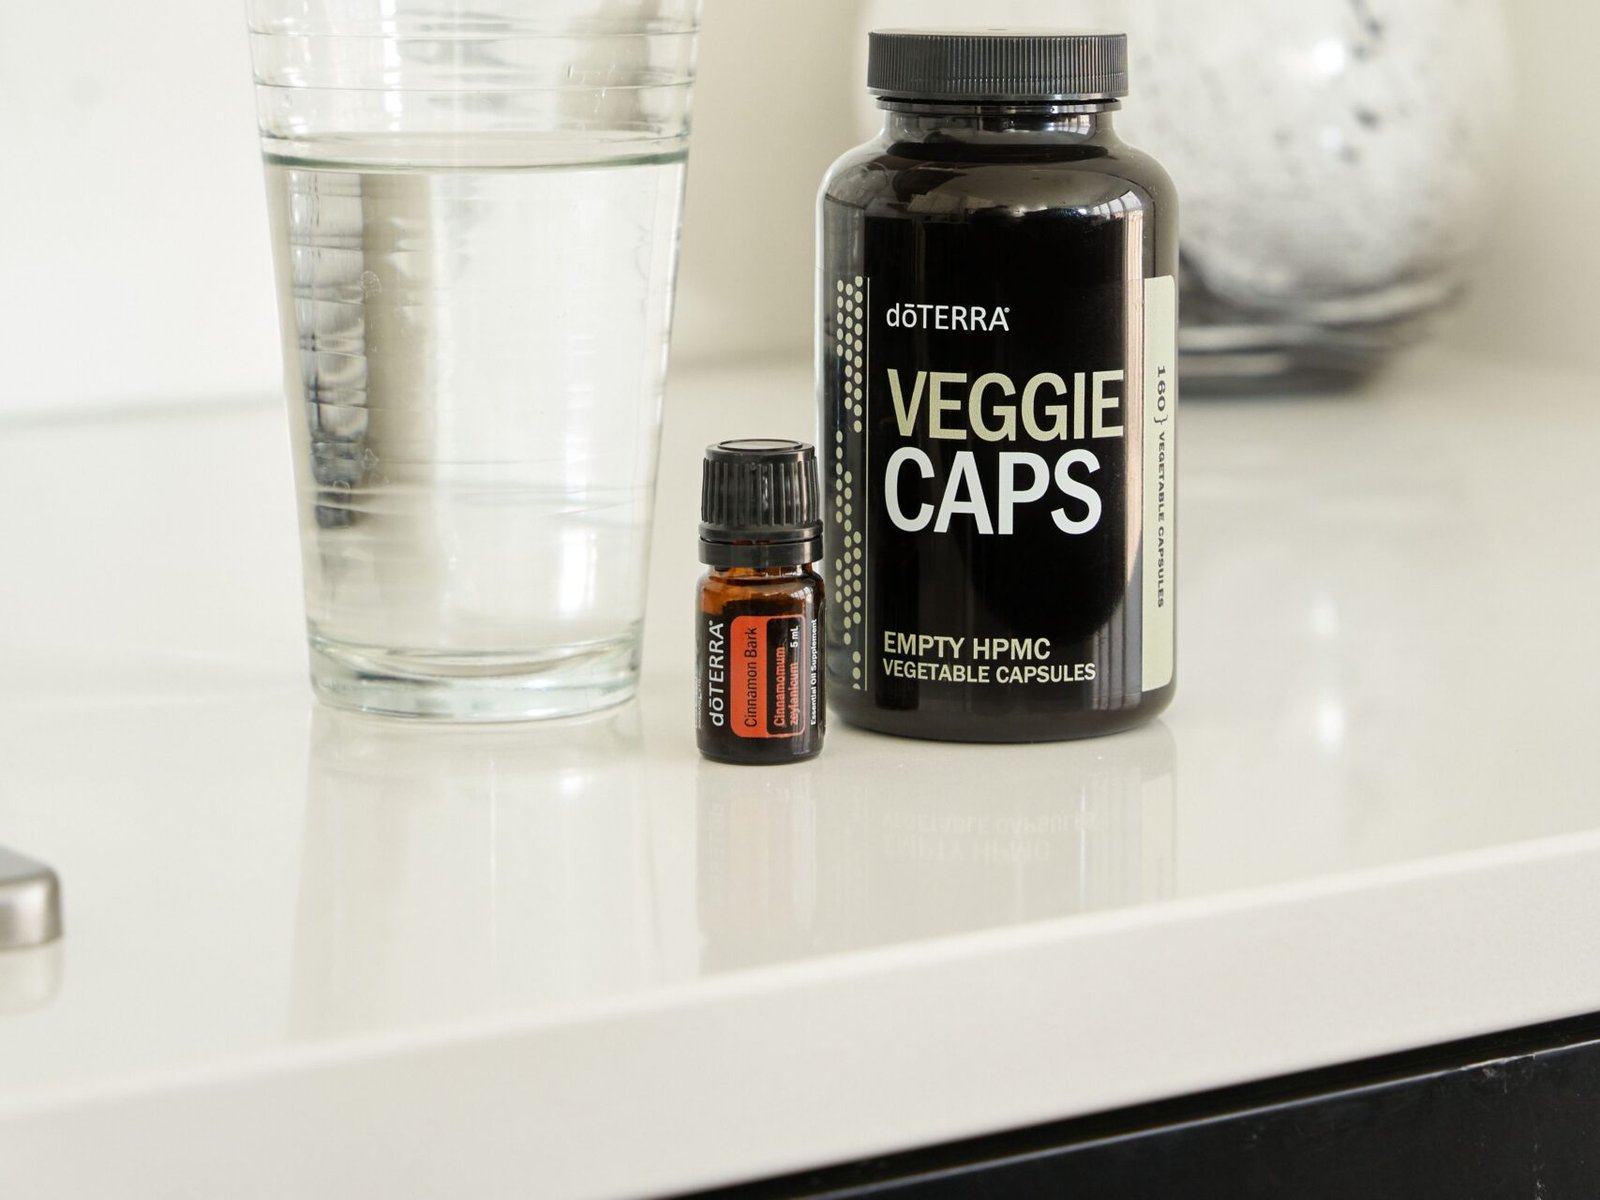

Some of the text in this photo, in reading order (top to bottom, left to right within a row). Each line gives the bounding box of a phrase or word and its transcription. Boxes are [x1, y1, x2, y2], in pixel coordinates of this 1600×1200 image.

[887, 368, 1124, 442] VEGGIE
[884, 446, 1102, 535] CAPS
[1158, 431, 1166, 522] VEGETABLE
[1157, 526, 1165, 608] CAPSULES
[790, 625, 799, 640] mL
[810, 618, 818, 671] Supplement
[884, 631, 1051, 660] EMPTY HPMC
[744, 627, 757, 728] Cinnamon Bark
[773, 647, 785, 726] Cinnamomum
[788, 662, 800, 726] zeylanicum
[883, 658, 1097, 684] VEGETABLE CAPSULES
